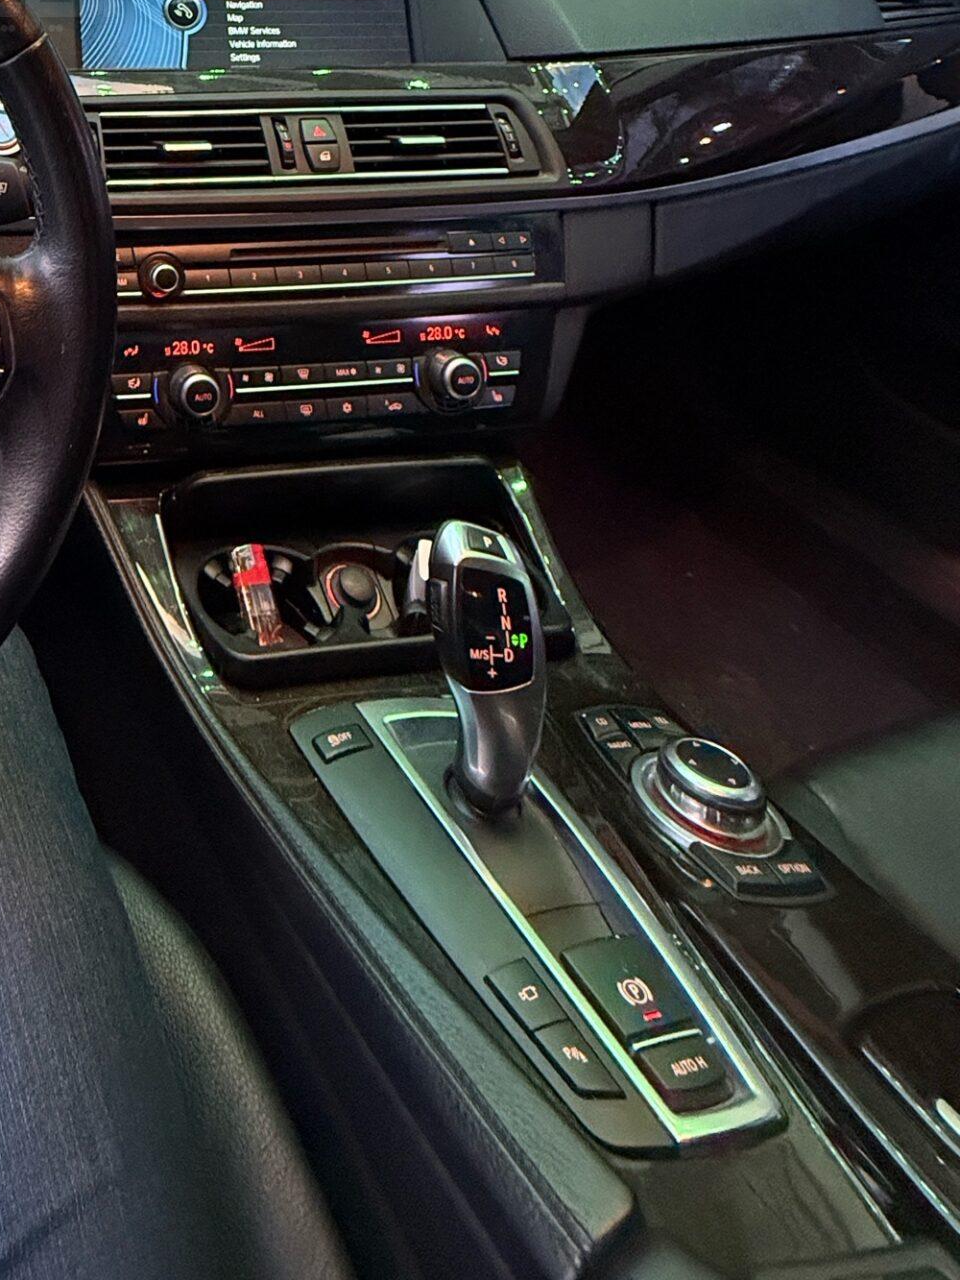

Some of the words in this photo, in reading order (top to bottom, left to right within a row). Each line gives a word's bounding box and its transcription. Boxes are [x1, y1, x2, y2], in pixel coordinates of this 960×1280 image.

[226, 1, 263, 10] Navigation
[227, 14, 244, 22] Map
[228, 27, 248, 35] BMW
[250, 27, 281, 35] Services
[229, 40, 255, 49] Vehicle
[230, 53, 261, 63] Settings
[427, 326, 453, 341] 28.0
[172, 340, 200, 356] 28.0
[335, 368, 350, 376] MAX
[457, 376, 475, 385] AUTO
[194, 392, 212, 402] AUTO
[253, 409, 265, 418] ALL
[483, 536, 492, 548] P
[497, 588, 507, 603] R
[500, 615, 511, 631] N
[519, 633, 528, 649] P
[469, 648, 489, 660] M/S
[504, 648, 515, 663] D
[735, 864, 763, 875] BACK
[778, 862, 812, 874] OPTION
[671, 1059, 698, 1077] AUTO
[696, 1055, 709, 1070] H
